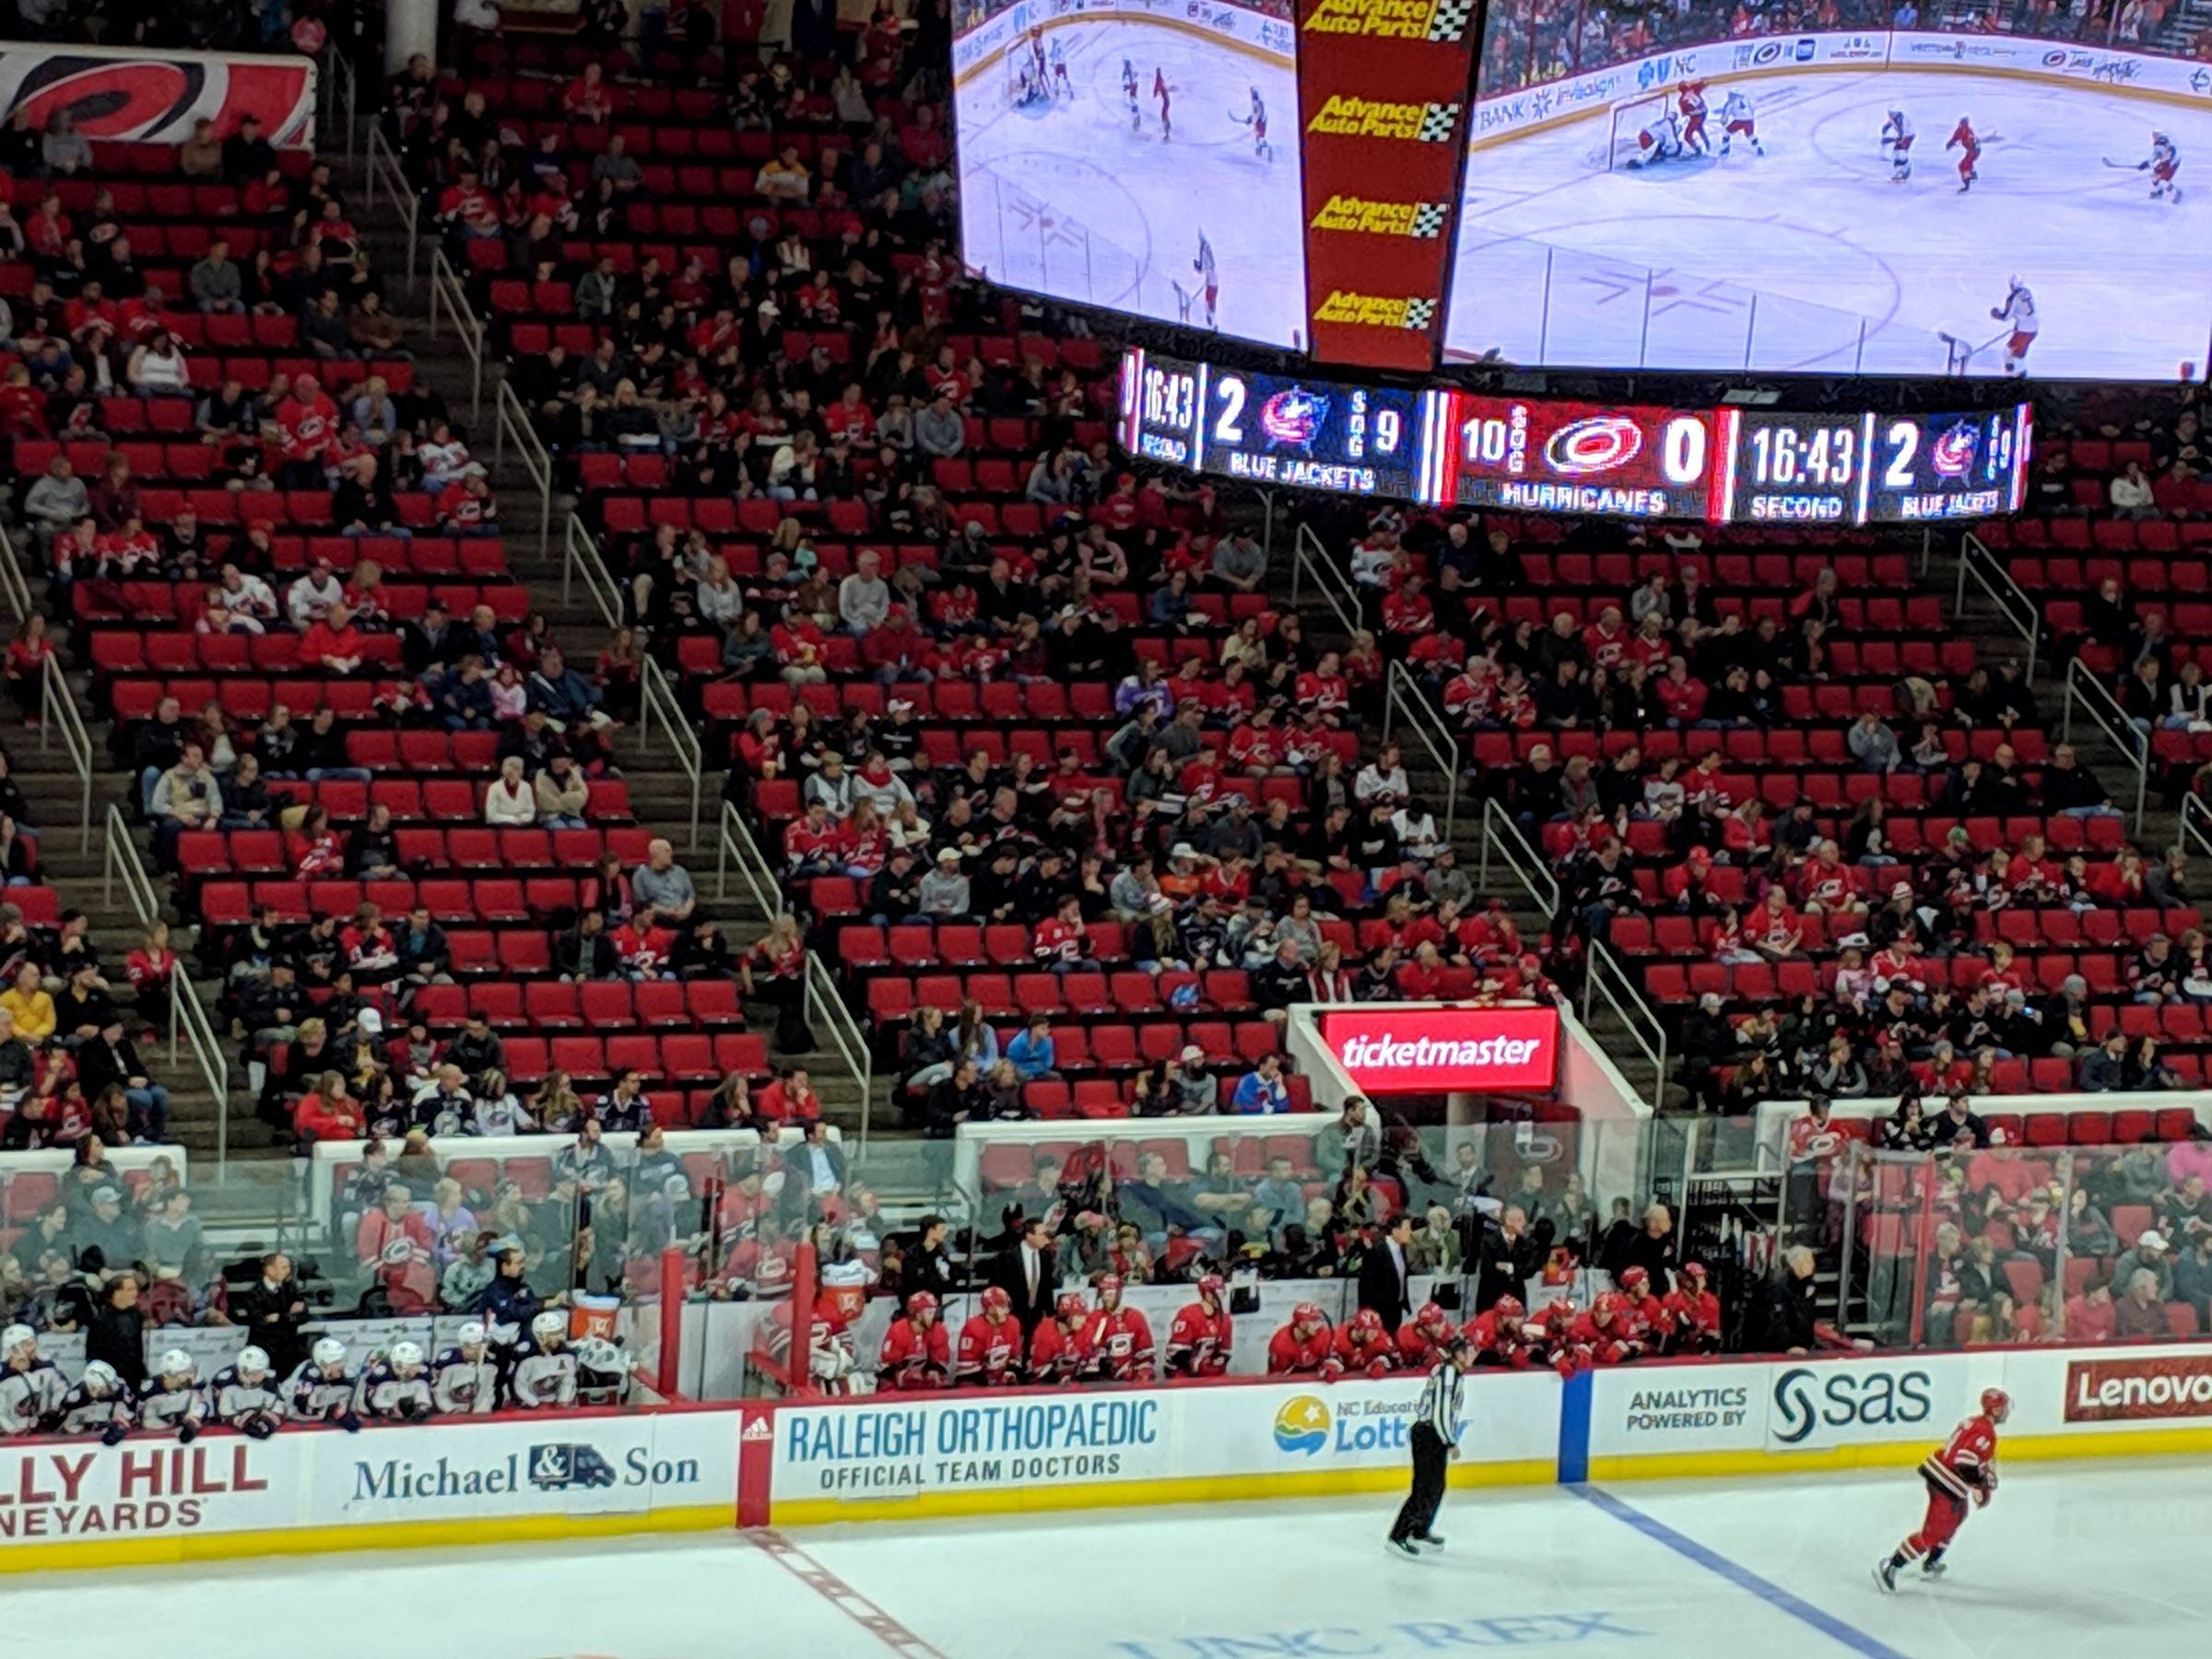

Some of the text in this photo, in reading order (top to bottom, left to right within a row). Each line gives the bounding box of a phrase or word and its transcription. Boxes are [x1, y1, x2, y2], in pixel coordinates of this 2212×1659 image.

[1303, 13, 1423, 38] Auto Parts
[1316, 0, 1429, 18] Advance
[1322, 95, 1421, 120] Advance
[1478, 100, 1523, 131] BANK
[1307, 115, 1418, 138] Auto Parts
[1310, 214, 1409, 235] Auto Parts
[1321, 195, 1413, 219] Advance
[1321, 290, 1406, 312] Advance
[1145, 366, 1194, 429] 16:43
[1215, 377, 1246, 441] 2
[1377, 411, 1398, 453] 9
[1463, 418, 1507, 462] 10
[1999, 429, 2011, 470] 9
[1665, 417, 1706, 484] 0
[1753, 427, 1855, 485] 16:43
[1885, 421, 1918, 488] 2
[1230, 451, 1377, 490] BLUE JACKETS
[1501, 482, 1667, 513] HURRICANES
[1751, 494, 1843, 519] SECOND
[1901, 493, 1945, 519] BLUE
[1341, 1033, 1541, 1068] ticketmaster
[1629, 1386, 1748, 1410] ANALYTICS
[1822, 1370, 1932, 1427] sas
[2078, 1372, 2212, 1407] Lenovo
[1336, 1401, 1361, 1417] NC
[1626, 1409, 1747, 1432] POWERED BY
[789, 1399, 1158, 1463] RALEIGH ORTHOPAEDIC
[120, 1444, 269, 1498] HILL
[351, 1443, 700, 1500] Michael & Son
[820, 1453, 1122, 1490] OFFICIAL TEAM DOCTORS
[1390, 1610, 1657, 1649] REX
